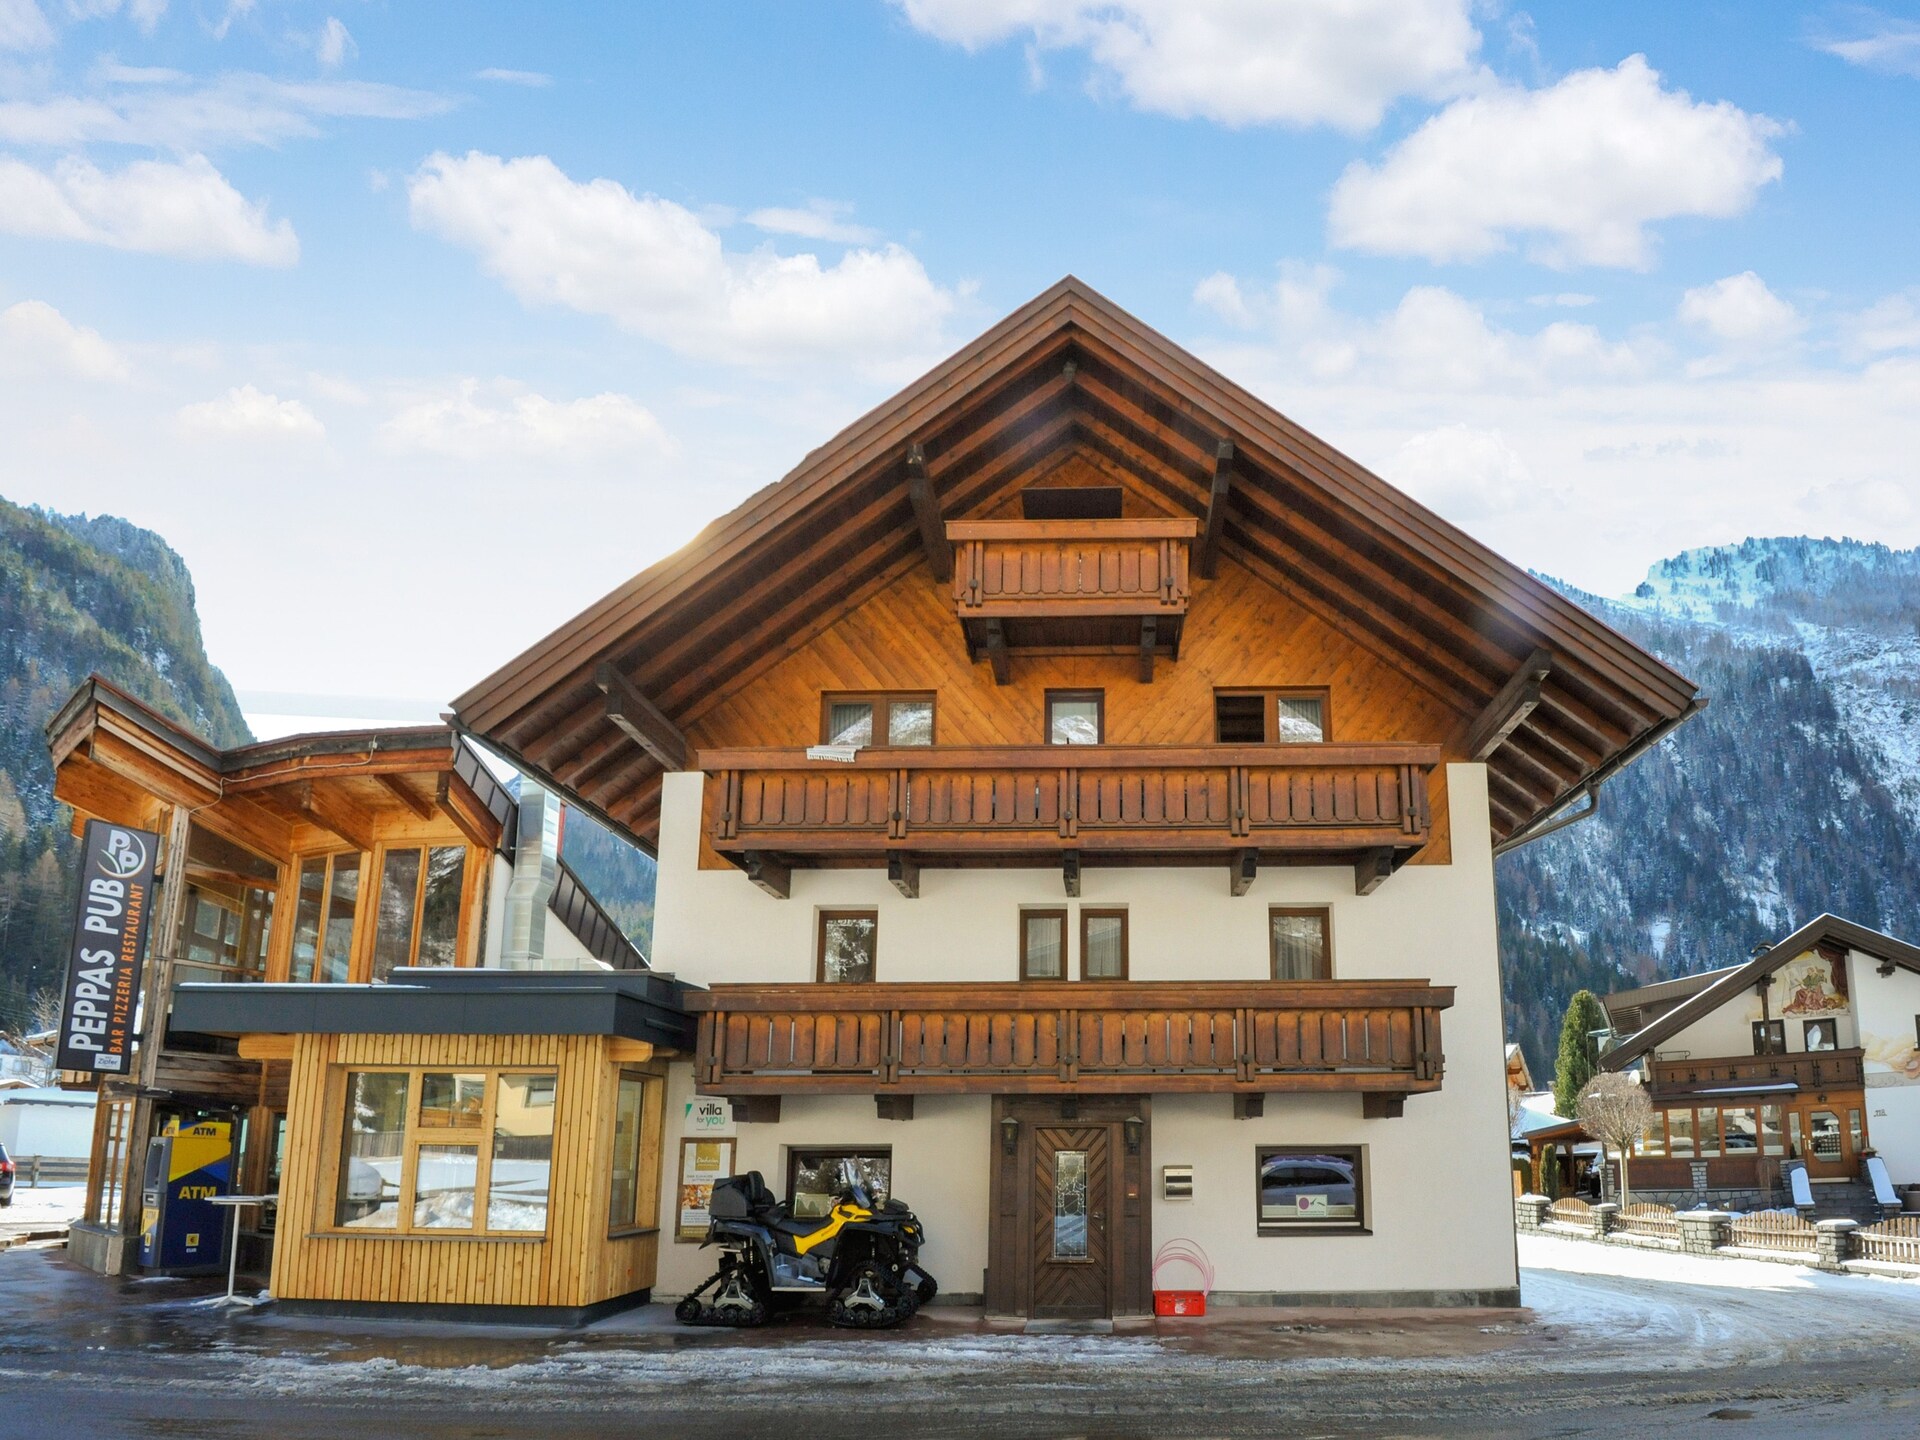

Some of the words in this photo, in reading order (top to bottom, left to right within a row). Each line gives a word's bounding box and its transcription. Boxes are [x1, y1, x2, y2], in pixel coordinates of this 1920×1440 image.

[84, 878, 125, 935] PUB
[120, 883, 144, 962] RESTAURANT
[68, 948, 116, 1052] PEPPAS
[113, 967, 133, 1024] PIZZERIA
[109, 1029, 126, 1054] BAR
[699, 1103, 722, 1116] villa
[705, 1116, 726, 1127] you
[193, 1127, 217, 1136] ATM
[178, 1186, 217, 1200] ATM
